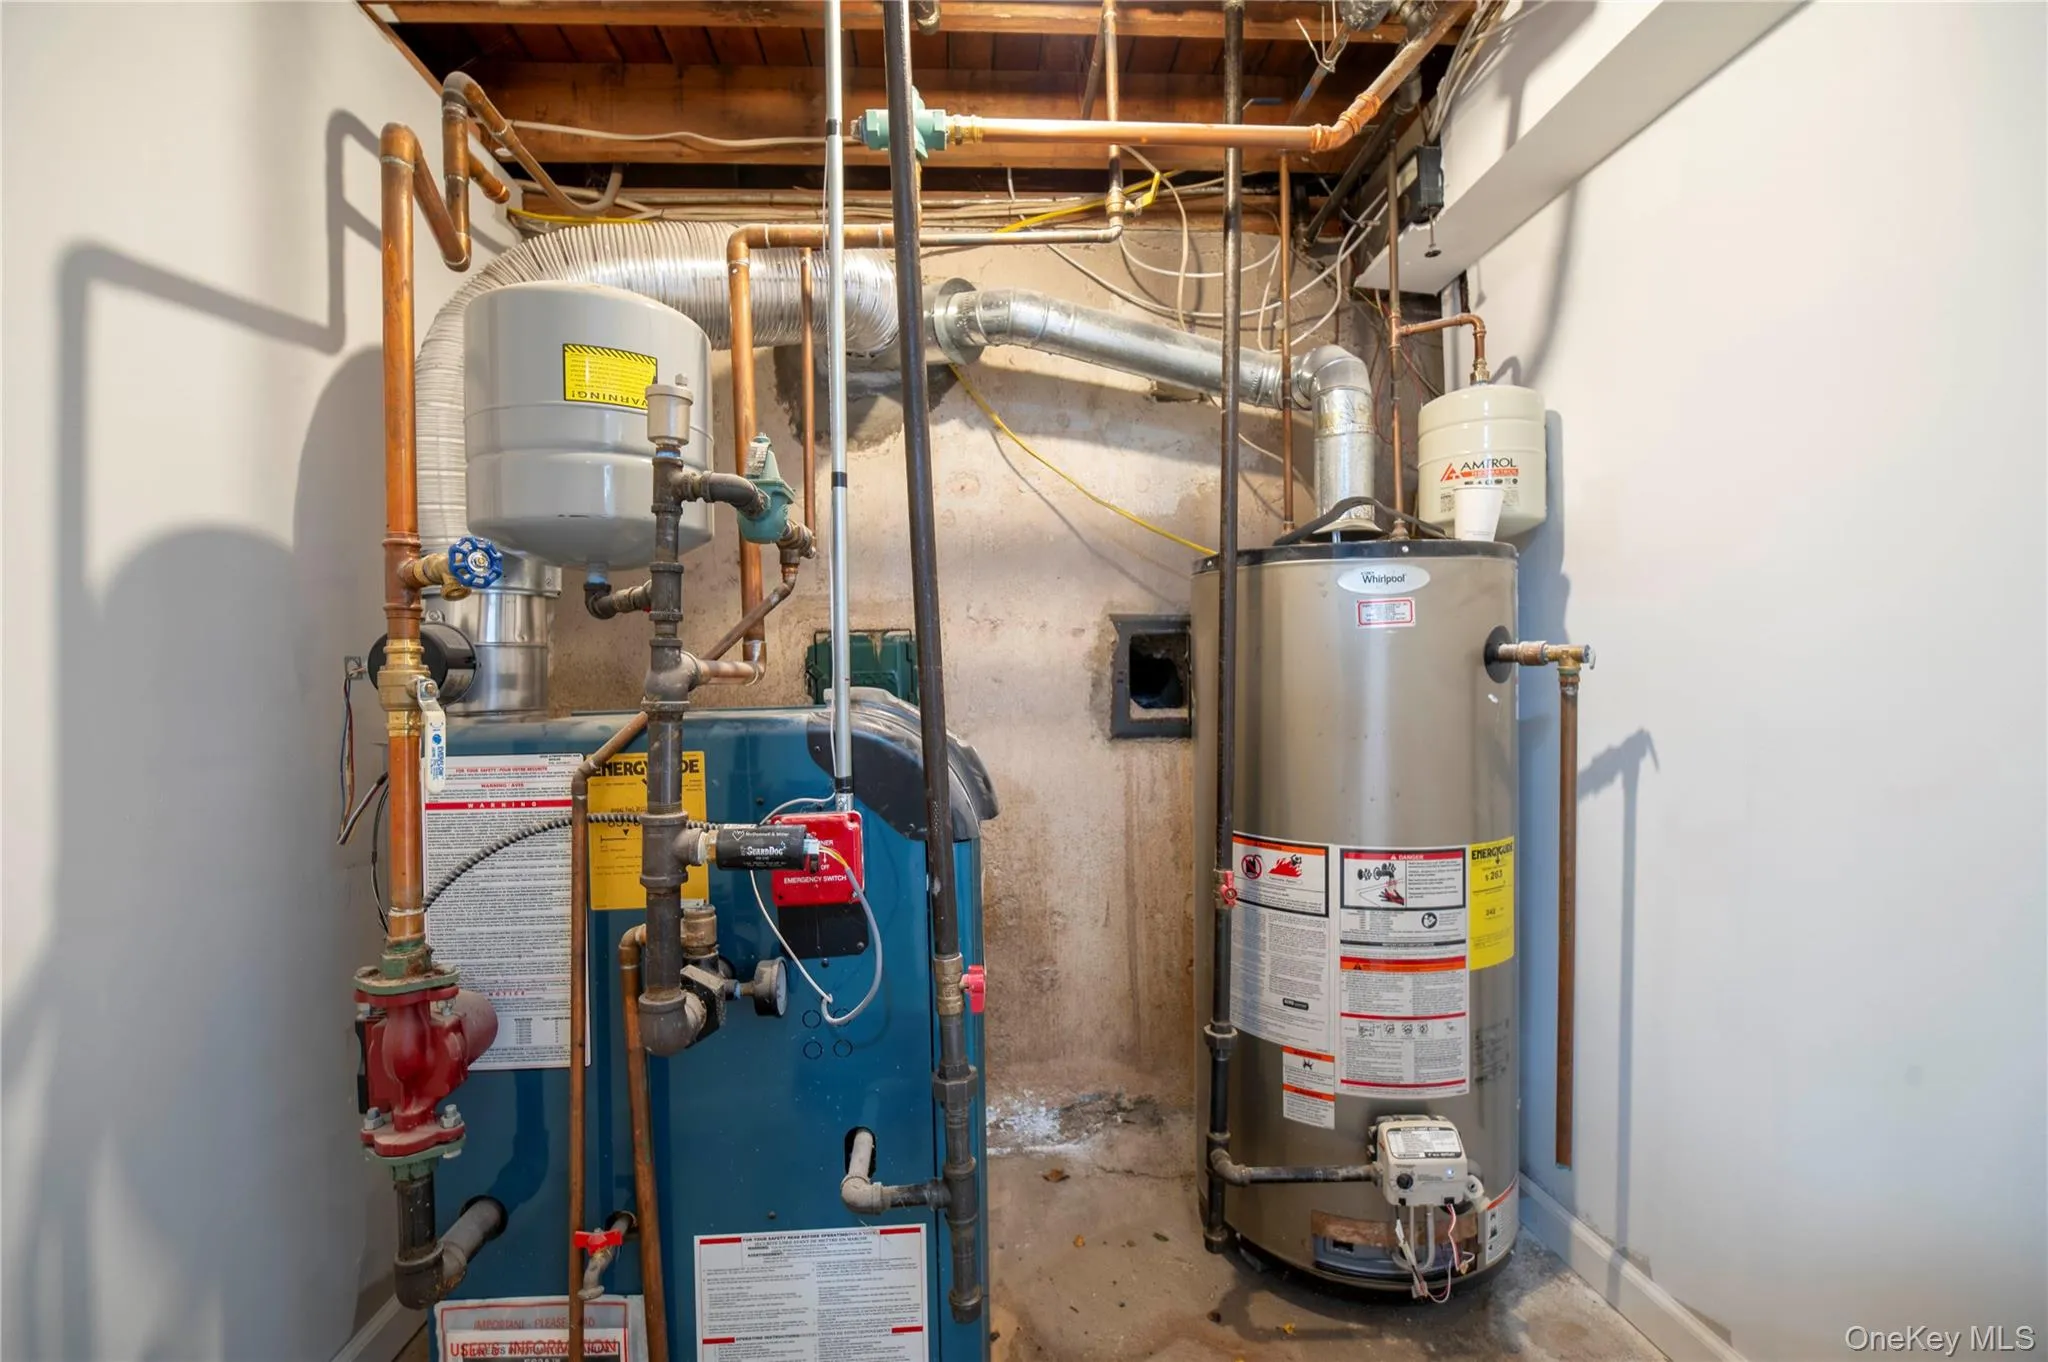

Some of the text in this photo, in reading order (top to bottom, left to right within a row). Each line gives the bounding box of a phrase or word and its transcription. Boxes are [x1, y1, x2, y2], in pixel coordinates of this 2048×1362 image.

[1460, 457, 1517, 471] AMTROL
[1362, 574, 1405, 585] Whirlpool
[784, 874, 847, 884] EMERGENCY SWITCH
